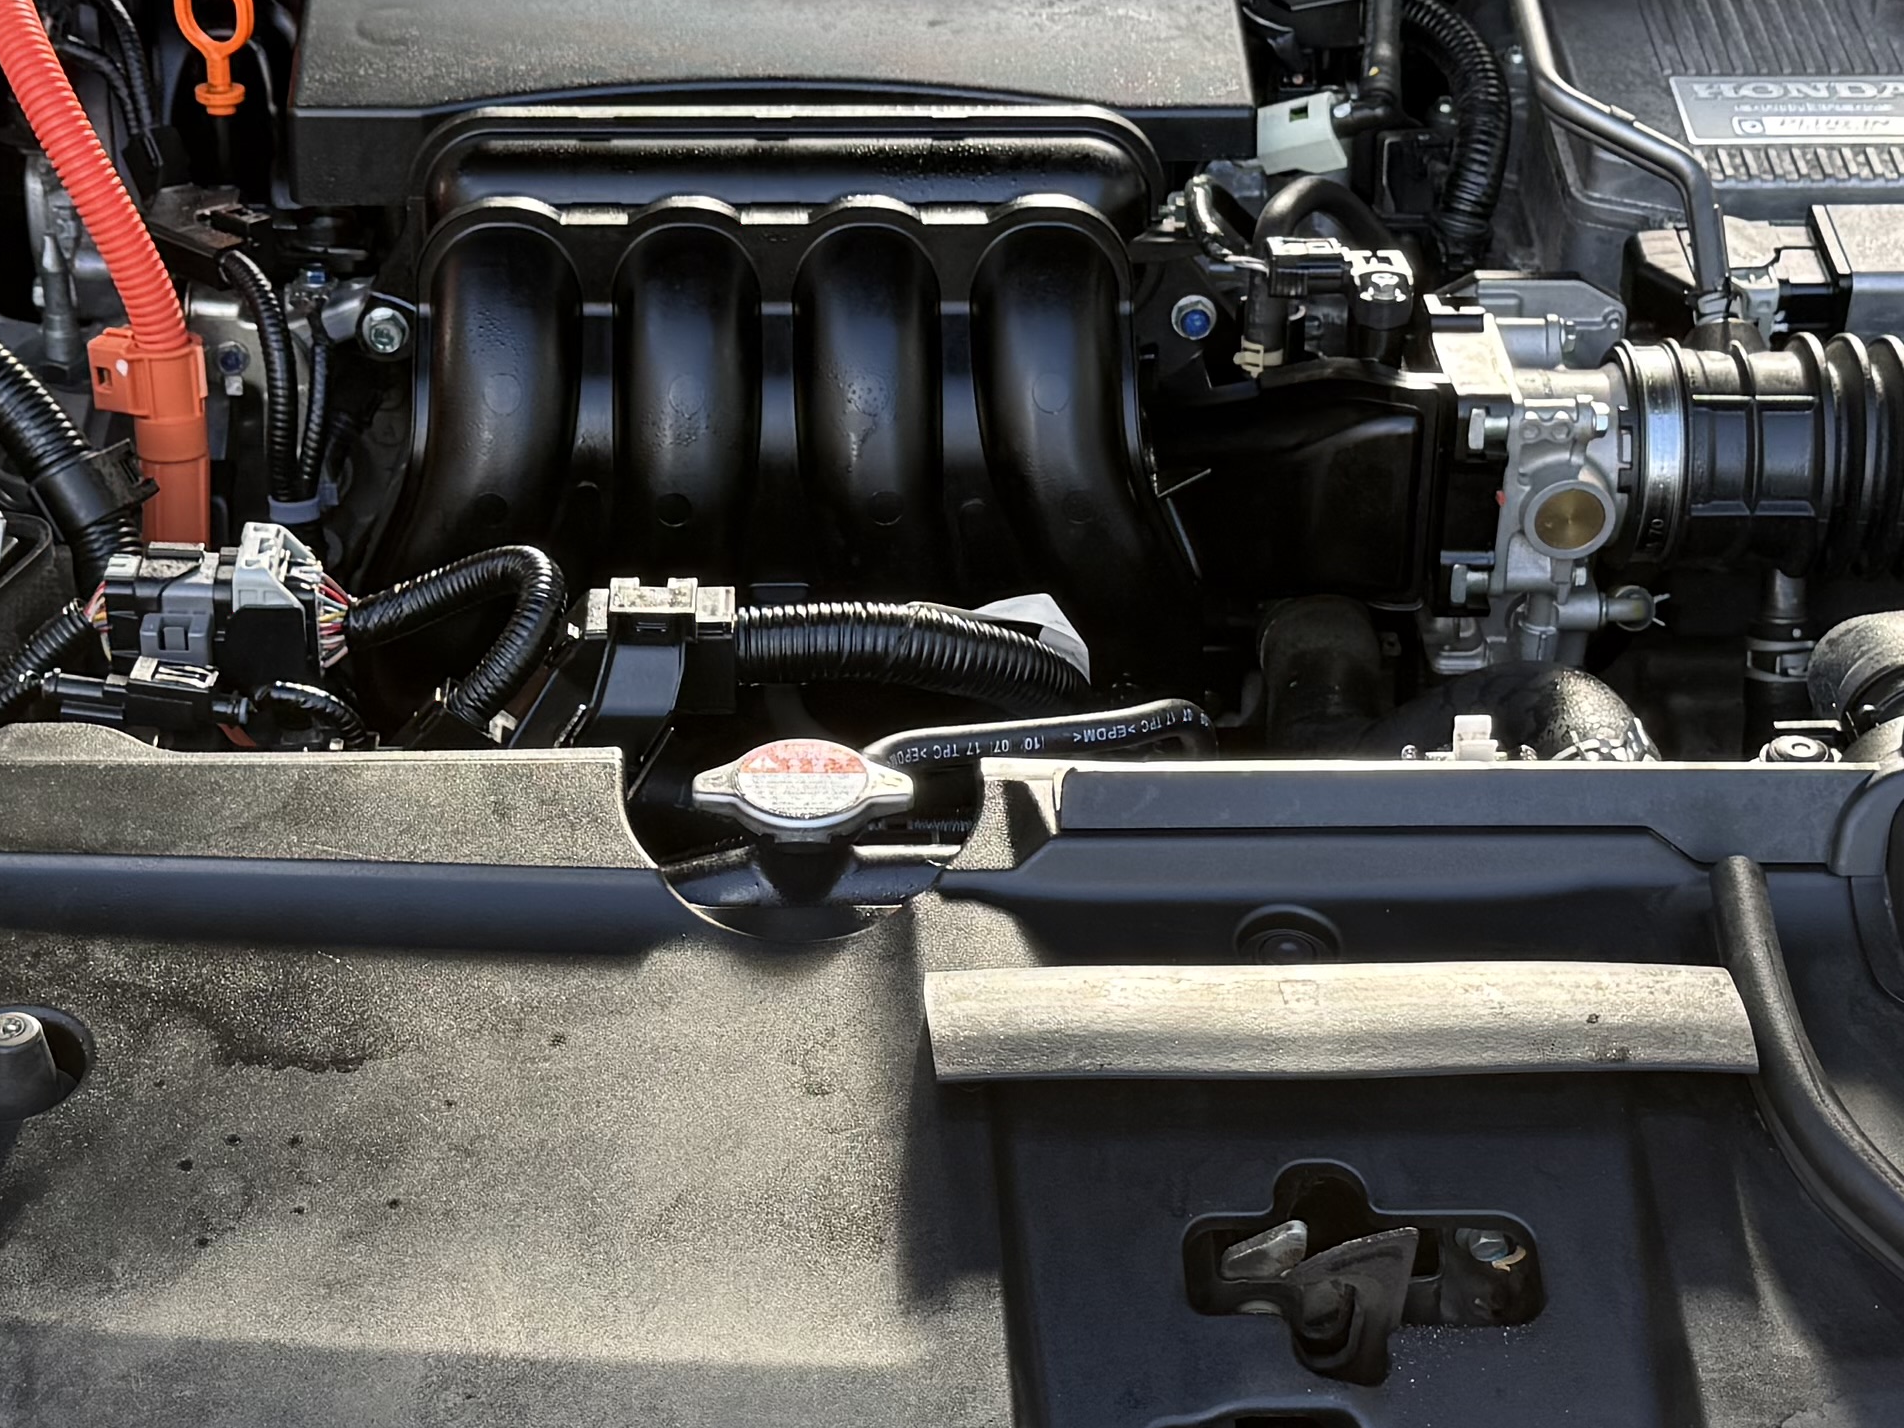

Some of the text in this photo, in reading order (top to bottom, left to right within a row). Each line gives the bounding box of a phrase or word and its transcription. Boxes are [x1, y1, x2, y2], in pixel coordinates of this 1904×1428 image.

[1140, 714, 1163, 733] TPC
[933, 743, 961, 760] TPC
[966, 741, 981, 756] 17
